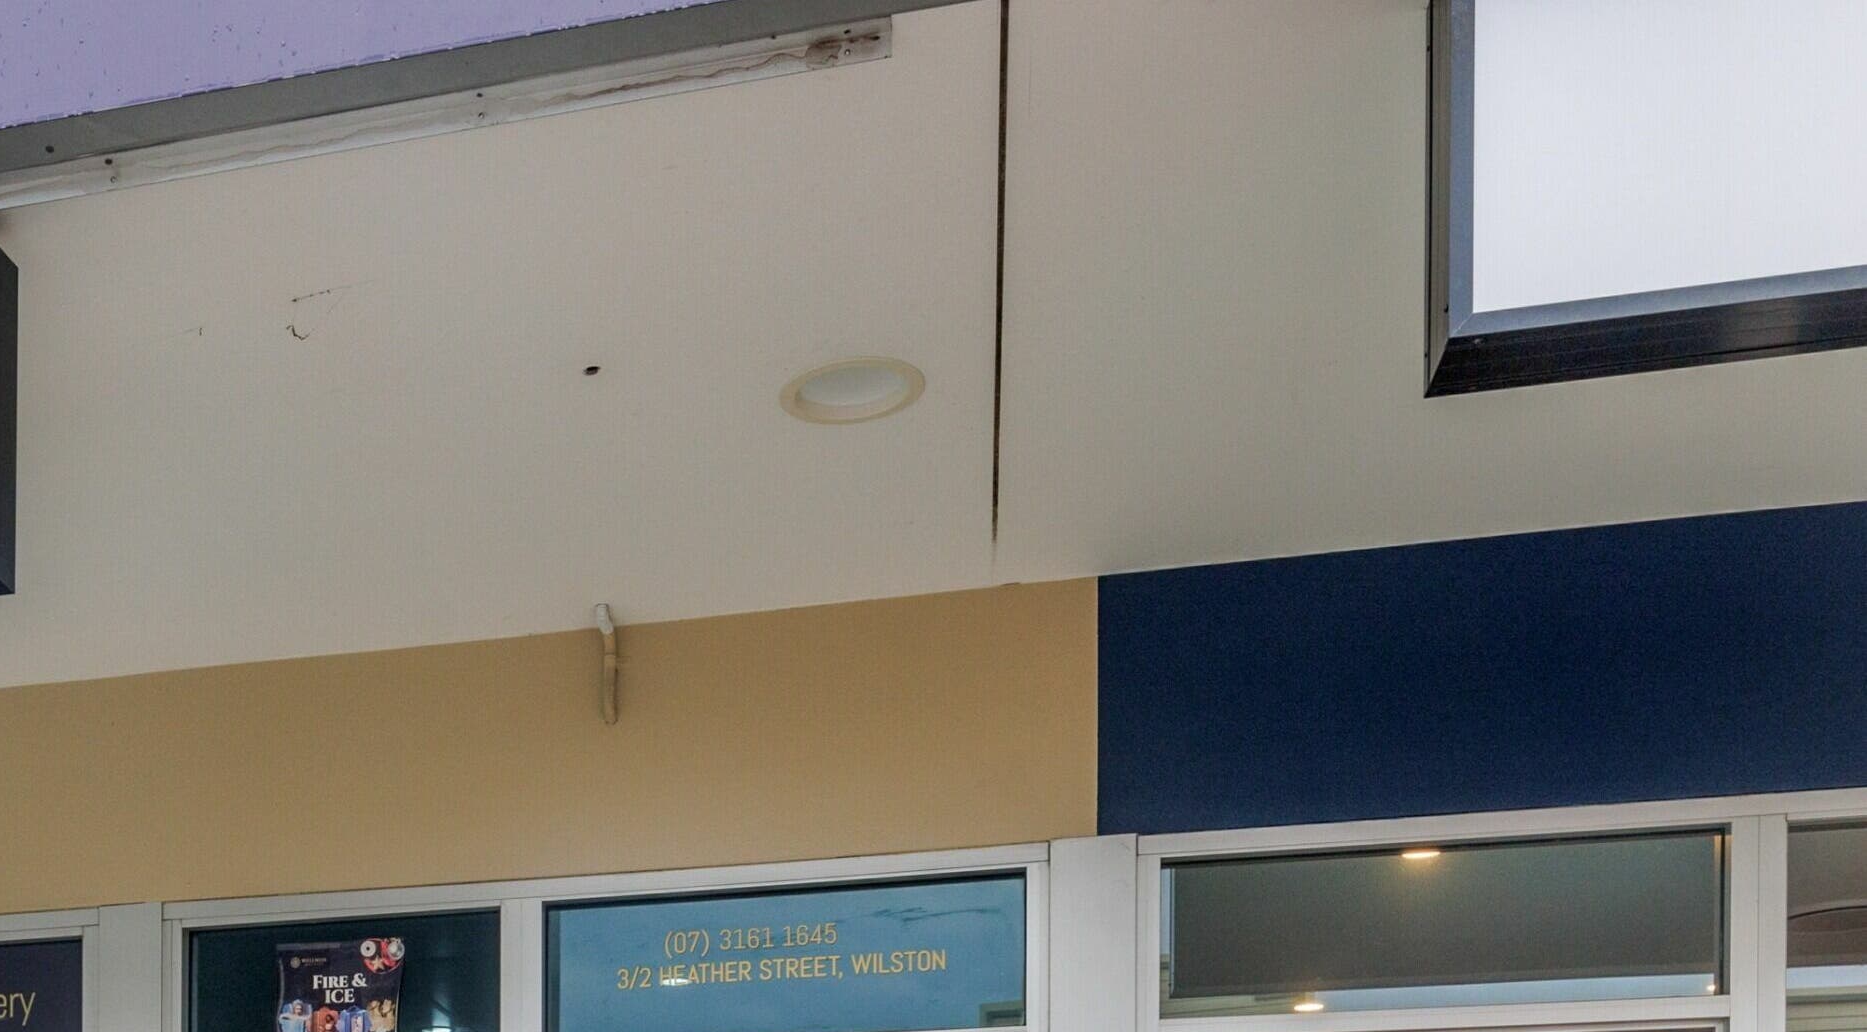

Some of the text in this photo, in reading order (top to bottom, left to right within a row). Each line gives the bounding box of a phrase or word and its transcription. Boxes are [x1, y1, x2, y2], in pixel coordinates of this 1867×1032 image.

[664, 922, 838, 959] (07) 3161 1645
[312, 972, 368, 989] FIRE &
[616, 949, 947, 991] 3/2 HEATHER STREET, WILSTON
[325, 988, 355, 1003] ICE
